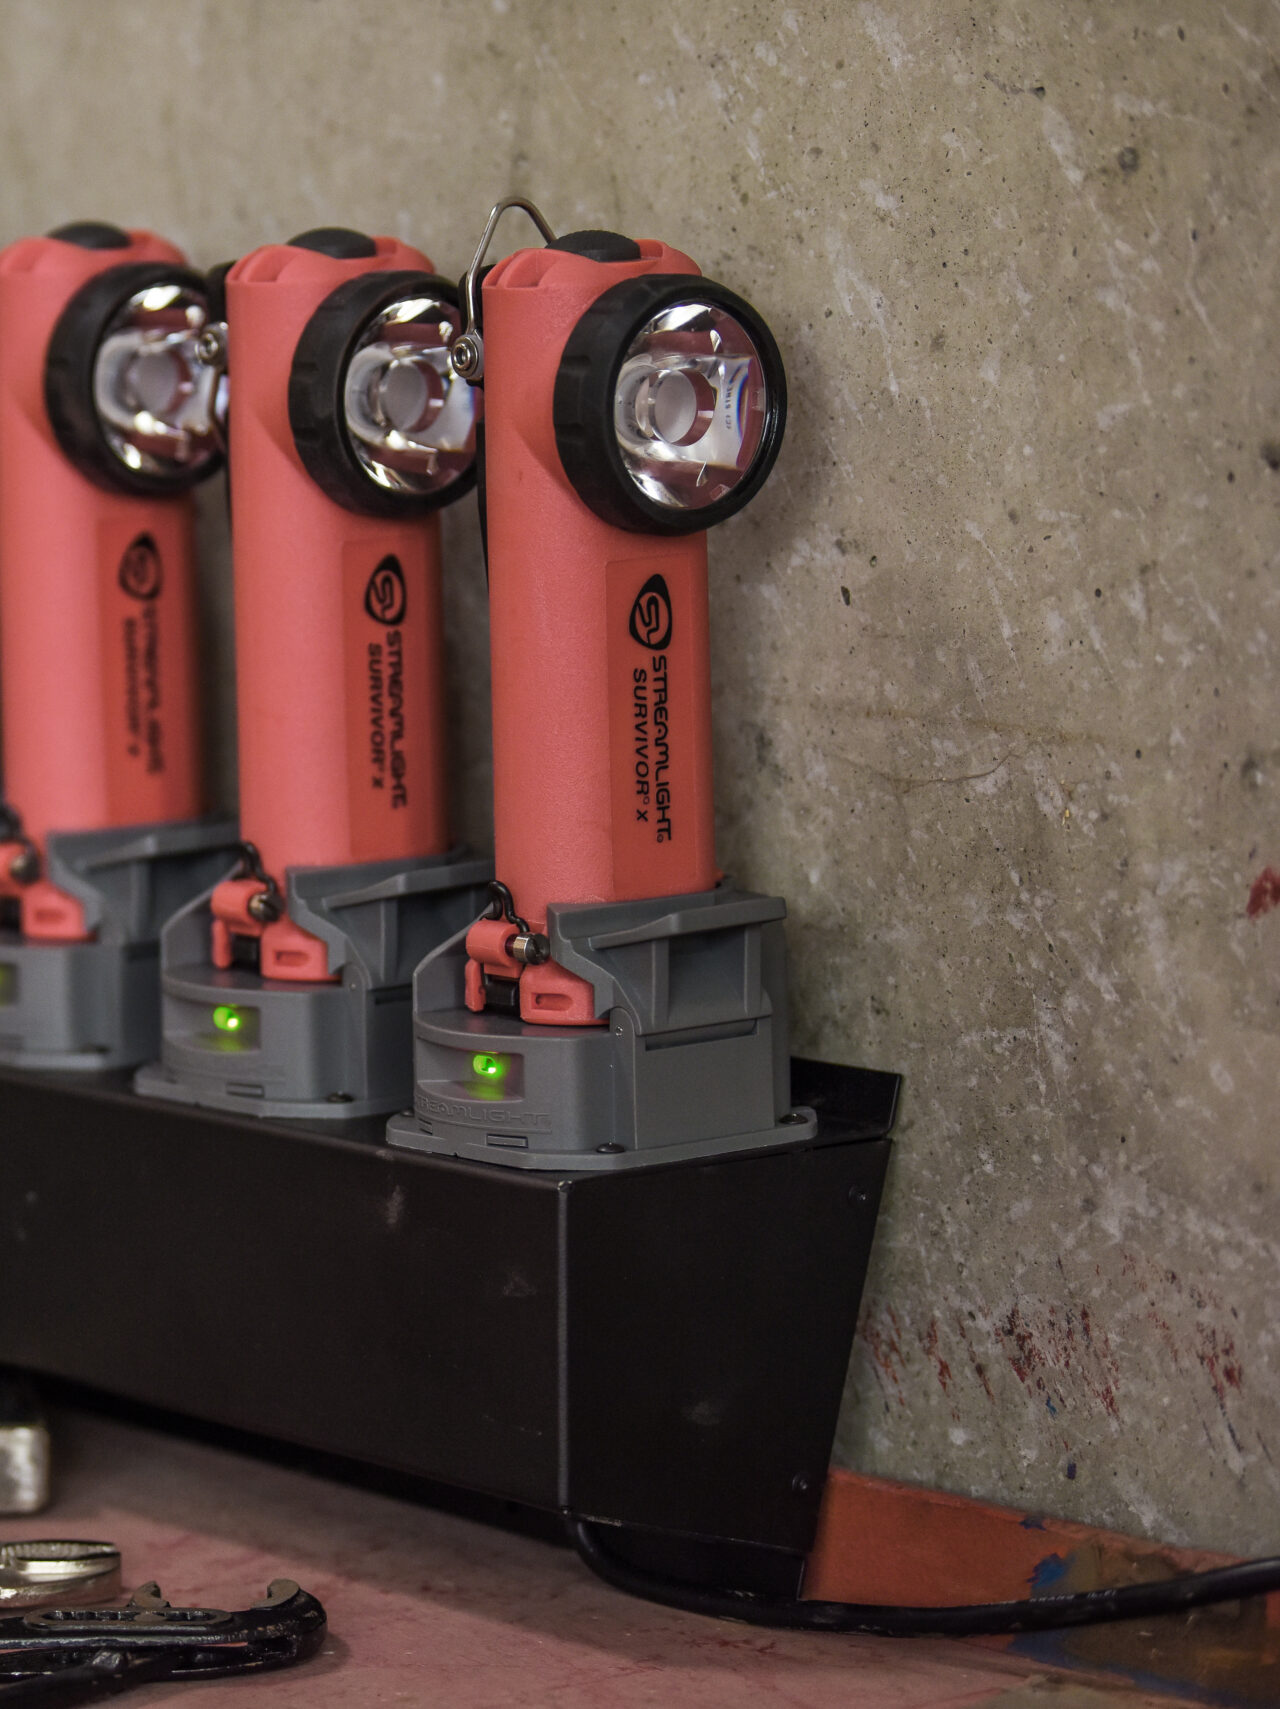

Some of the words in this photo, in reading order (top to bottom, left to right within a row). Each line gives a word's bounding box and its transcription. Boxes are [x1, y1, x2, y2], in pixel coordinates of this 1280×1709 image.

[633, 668, 650, 797] SURVIVOR
[652, 654, 672, 841] STREAMLIGHT
[636, 809, 649, 822] X
[415, 1094, 549, 1125] TREAMLIGHT
